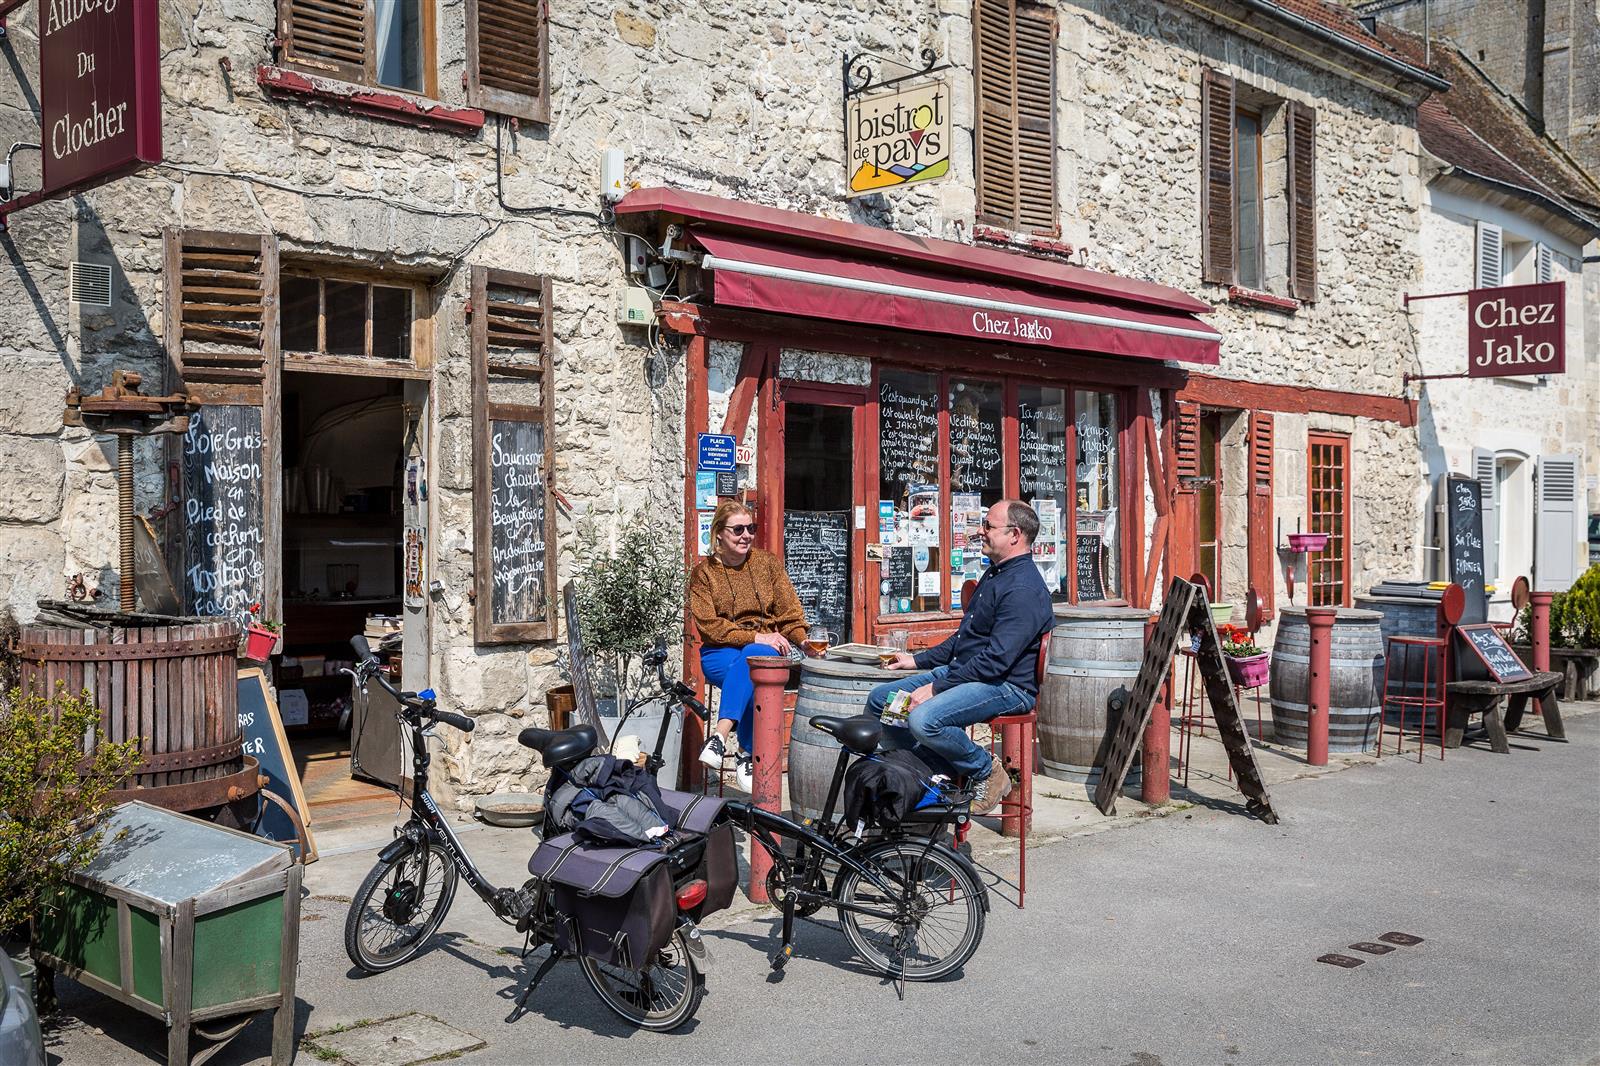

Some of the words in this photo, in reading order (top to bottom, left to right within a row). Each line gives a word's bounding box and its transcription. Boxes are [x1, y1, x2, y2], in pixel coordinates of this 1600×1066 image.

[77, 52, 96, 79] Du
[52, 101, 127, 160] Clocher
[854, 92, 944, 142] bistrot
[853, 143, 870, 160] de
[872, 131, 941, 178] pays
[972, 311, 1011, 335] Chez
[1474, 298, 1555, 329] Chez
[1476, 335, 1555, 366] Jako
[225, 427, 262, 450] Gras
[895, 421, 917, 430] JAKO
[491, 433, 545, 467] Saucisson
[736, 449, 751, 462] 30
[204, 462, 262, 484] Maison
[505, 467, 542, 489] chaud
[187, 498, 223, 525] Pied
[228, 502, 247, 522] de
[206, 524, 264, 546] cochon
[194, 588, 255, 617] Façon
[238, 711, 255, 728] RAS
[241, 737, 266, 754] TER
[435, 821, 477, 888] VENTURELLI
